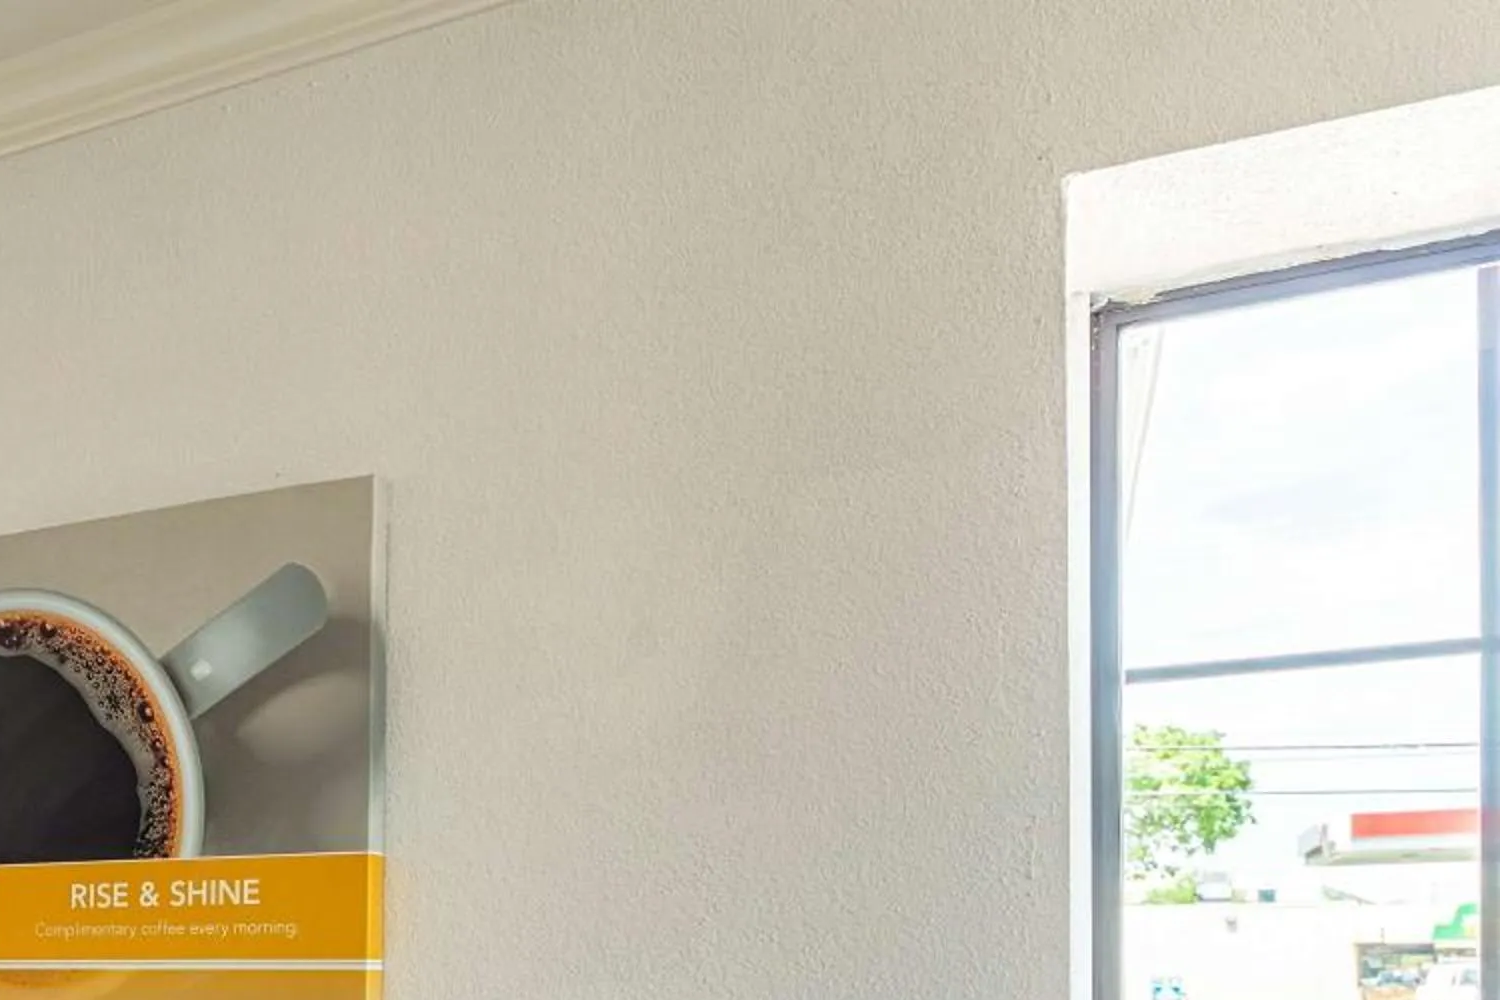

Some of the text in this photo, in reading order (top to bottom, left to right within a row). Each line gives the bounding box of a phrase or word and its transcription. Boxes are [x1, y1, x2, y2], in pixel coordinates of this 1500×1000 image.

[70, 879, 260, 910] RISE & SHINE
[34, 921, 137, 941] Complimentary
[141, 919, 185, 936] coffee
[189, 922, 228, 938] every
